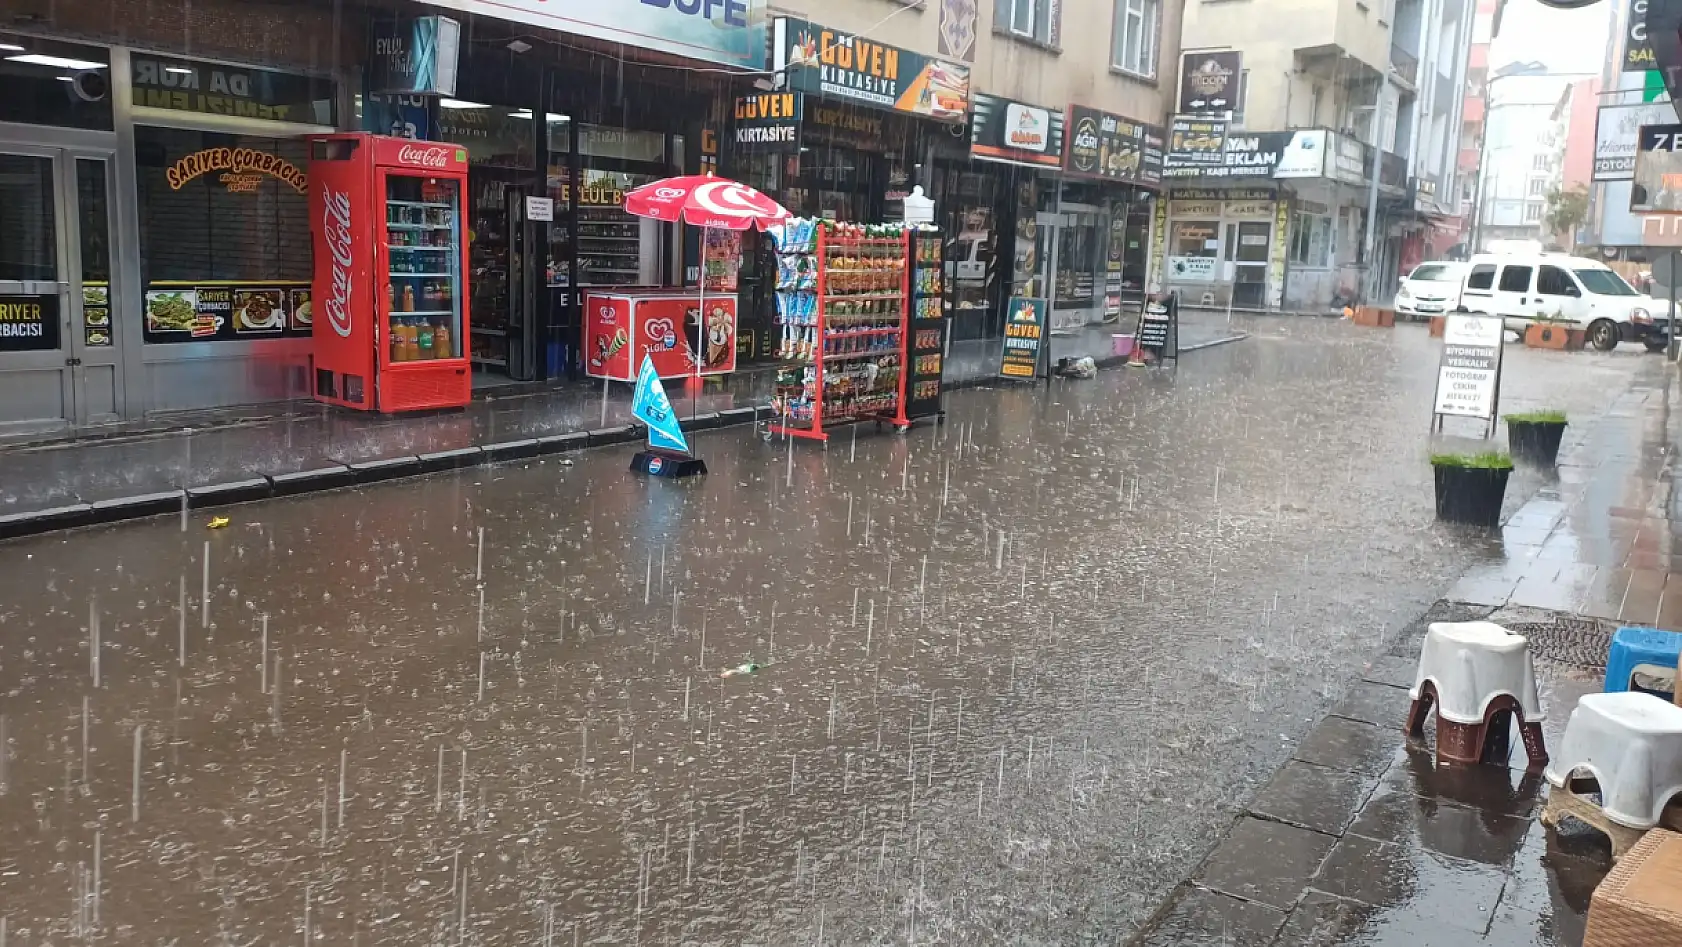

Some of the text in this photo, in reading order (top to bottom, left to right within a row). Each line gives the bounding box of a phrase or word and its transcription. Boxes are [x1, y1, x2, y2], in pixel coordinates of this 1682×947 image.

[820, 31, 898, 79] GÜVEN
[821, 65, 896, 96] KIRTASİYE
[735, 94, 795, 119] GÜVEN
[736, 124, 796, 143] KIRTASİYE
[1227, 138, 1259, 150] YAN
[166, 148, 231, 191] SARIYER
[0, 322, 43, 337] BACISI
[1005, 323, 1041, 339] GÜVEN
